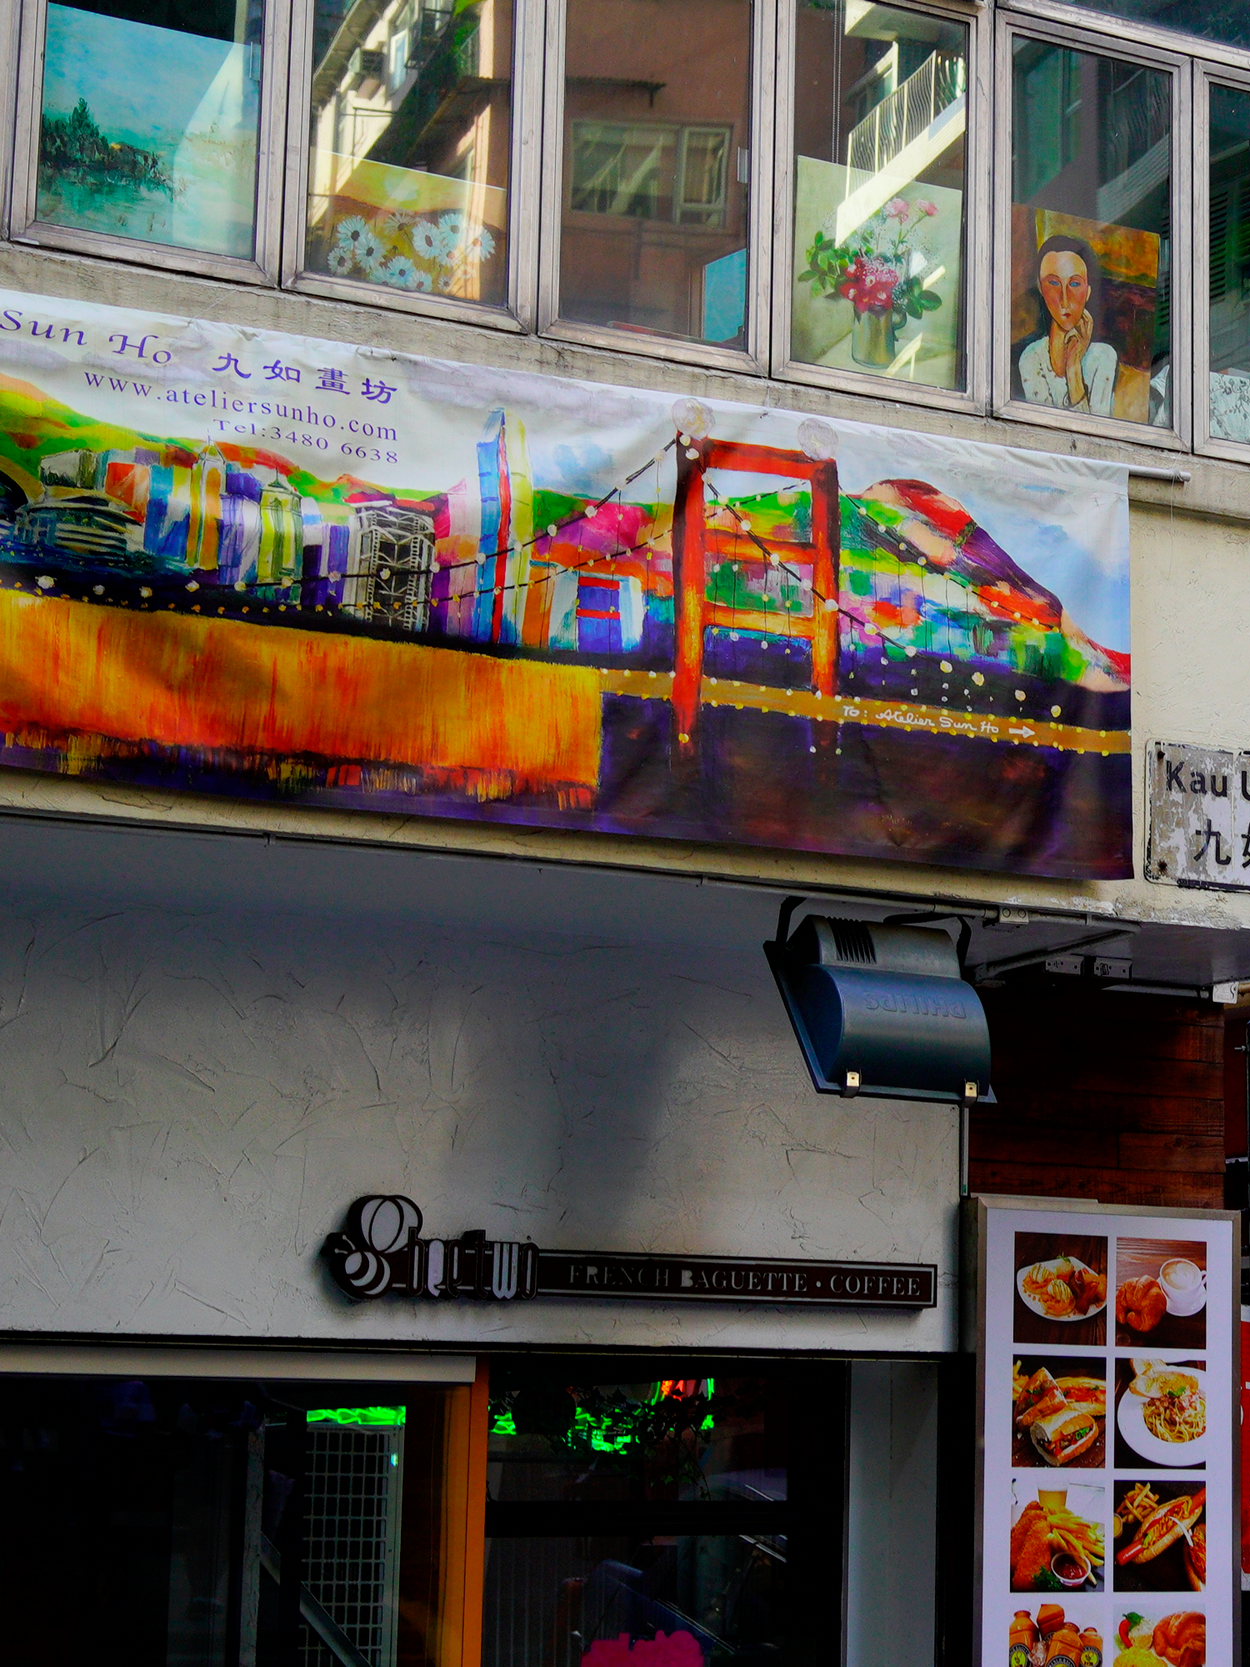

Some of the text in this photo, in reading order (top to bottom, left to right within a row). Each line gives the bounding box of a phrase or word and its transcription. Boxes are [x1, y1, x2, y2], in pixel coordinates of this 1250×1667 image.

[0, 309, 172, 365] Sun Ho
[211, 352, 398, 404] 九如畫坊
[84, 371, 398, 442] www.ateliersunho.com
[212, 418, 399, 464] Tel:3480 6638
[875, 708, 935, 727] Atelier
[939, 716, 977, 732] Sun
[980, 721, 999, 734] Ho
[1166, 760, 1228, 798] Kau
[568, 1264, 923, 1297] FRENCH BAGUETTE COFFEE
